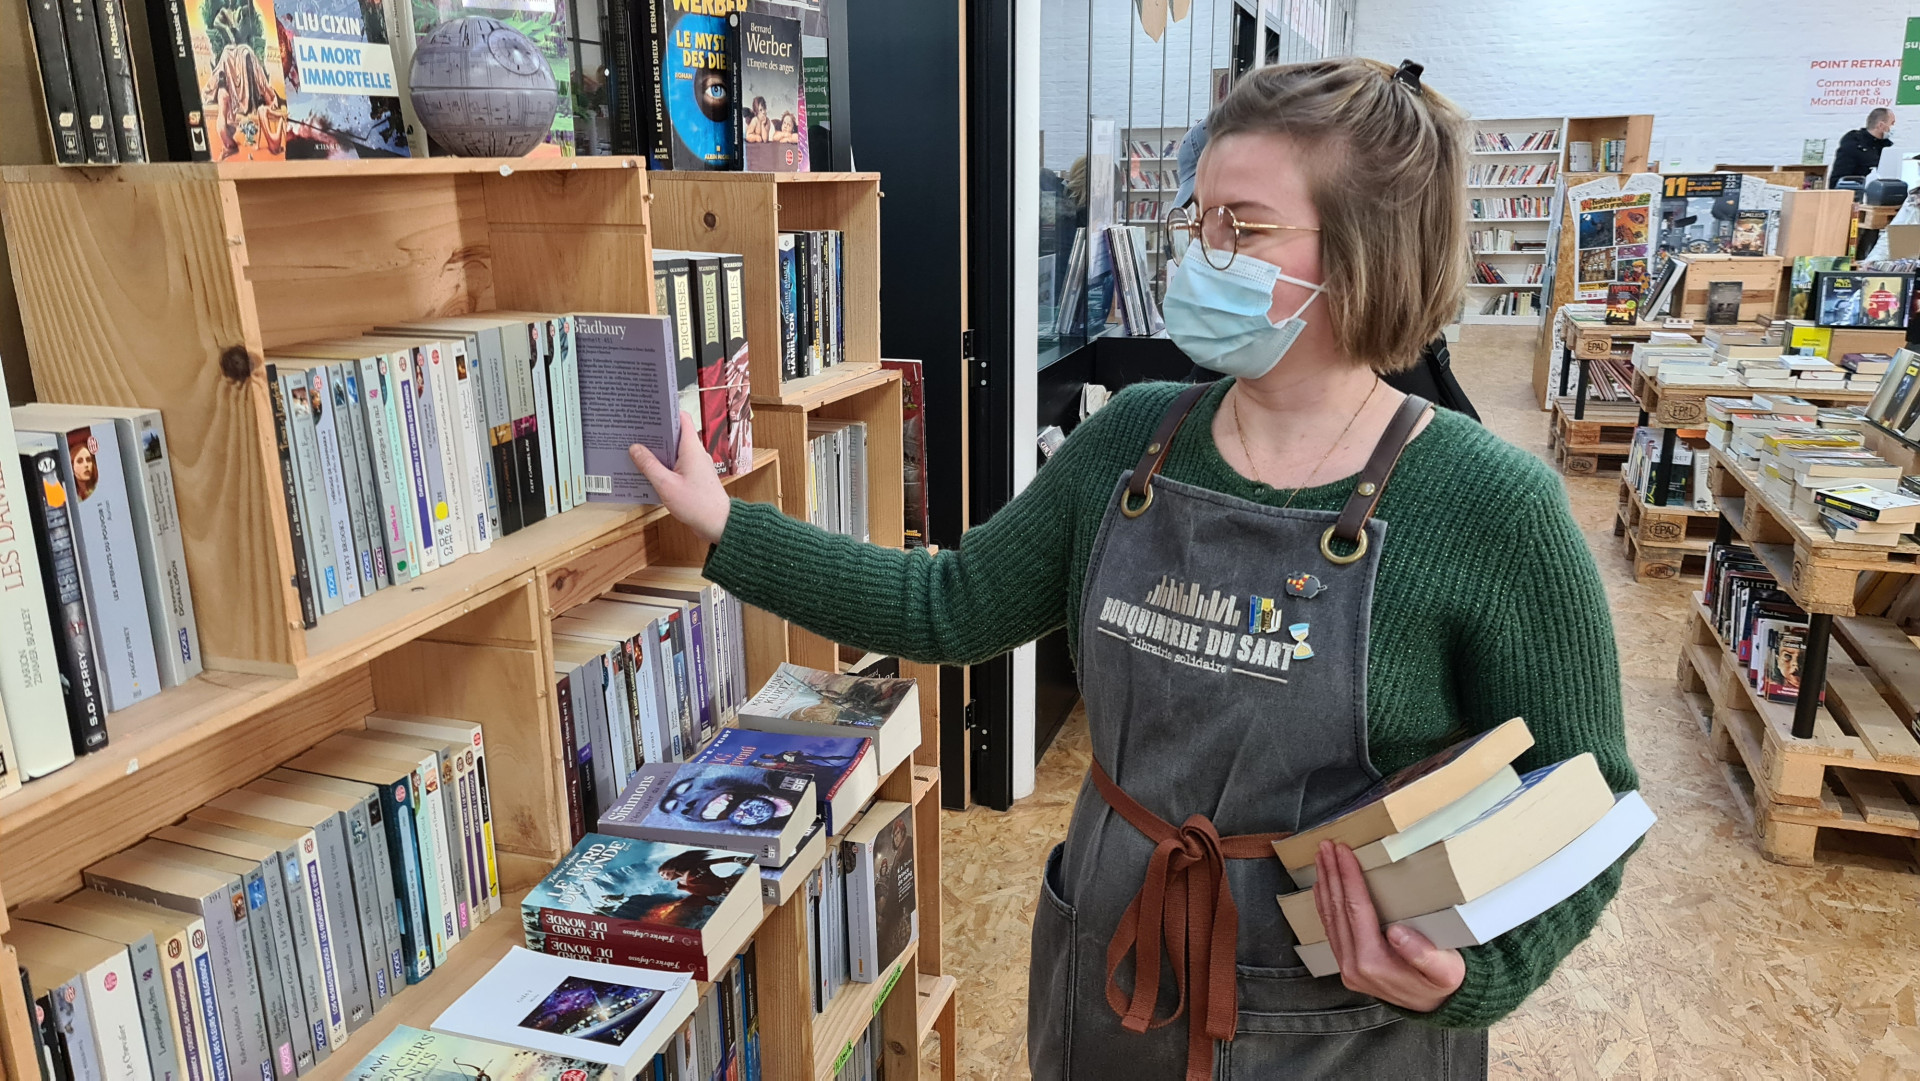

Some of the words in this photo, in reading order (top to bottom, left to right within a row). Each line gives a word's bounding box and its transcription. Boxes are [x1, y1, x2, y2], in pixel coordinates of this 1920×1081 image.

[106, 2, 114, 14] de
[170, 2, 178, 13] de
[108, 15, 120, 46] Messie
[172, 14, 184, 46] Messie
[294, 11, 318, 32] LIU
[320, 14, 360, 35] CIXIN
[750, 22, 772, 34] Bernard
[114, 47, 122, 59] Le
[179, 46, 186, 58] Le
[676, 30, 692, 48] LE
[695, 34, 726, 53] MYST
[746, 32, 792, 58] Werber
[299, 44, 318, 62] LA
[320, 46, 362, 66] MORT
[683, 52, 706, 68] DES
[710, 54, 728, 70] DIE
[747, 58, 768, 70] L'Empire
[770, 61, 778, 70] des
[779, 64, 794, 74] anges
[1810, 60, 1849, 70] POINT
[1851, 58, 1903, 69] RETRAIT
[302, 68, 392, 88] IMMORTELLE
[675, 72, 692, 80] ROMAN
[1816, 78, 1892, 88] Commandes
[654, 83, 662, 120] MYSTÈRE
[1810, 97, 1857, 106] Mondial
[1860, 97, 1893, 108] Relay
[1824, 88, 1870, 97] internet
[1874, 88, 1880, 96] &
[656, 123, 663, 132] LE
[1664, 177, 1688, 197] 11
[706, 280, 716, 338] RUMEURS
[730, 275, 740, 332] REBELLES
[678, 281, 689, 352] TRICHEUSES
[574, 320, 626, 340] Bradbury
[1588, 342, 1606, 350] EPAL
[404, 384, 412, 408] BANNIS
[479, 414, 485, 422] La
[1673, 406, 1695, 417] EPAL
[376, 428, 384, 436] de
[409, 424, 417, 448] CHEMIN
[377, 438, 389, 471] sortilèges
[382, 472, 391, 484] Les
[389, 505, 397, 518] Lee
[98, 509, 109, 540] POUVOIR
[339, 520, 349, 552] BROOKS
[391, 521, 400, 541] Tanith
[477, 513, 486, 540] POCKET
[1654, 524, 1676, 535] EPAL
[104, 542, 111, 552] DU
[2, 550, 25, 592] LES
[106, 553, 117, 588] ARTEFACTS
[343, 554, 353, 580] TERRY
[361, 550, 372, 581] POCKET
[374, 547, 384, 576] POCKET
[171, 560, 184, 616] DONALDSON
[325, 565, 337, 598] POCKET
[112, 590, 120, 600] LES
[21, 608, 35, 646] BRADLEY
[1100, 597, 1202, 652] BOUQUINERIE
[1205, 628, 1236, 658] DU
[1236, 634, 1295, 670] SART
[179, 628, 190, 664] POCKET
[1131, 637, 1172, 660] librairie
[1174, 654, 1226, 673] solidaire
[18, 650, 34, 688] MARION
[78, 650, 95, 697] PERRY
[752, 674, 784, 707] KATHERINE
[764, 680, 792, 705] KURTZ
[793, 779, 808, 792] SF
[608, 775, 656, 822] Simmons
[548, 880, 568, 898] LE
[566, 844, 606, 877] BORD
[580, 841, 626, 882] MONDE
[314, 889, 321, 898] DE
[444, 912, 453, 938] POCKET
[459, 902, 468, 928] POCKET
[546, 914, 586, 928] MONDE
[592, 921, 607, 932] DU
[552, 925, 585, 938] BORD
[589, 932, 604, 940] LE
[622, 929, 648, 938] Anfosso
[650, 932, 674, 944] Fabrice
[323, 947, 331, 969] BUJOLD
[551, 940, 592, 954] MONDE
[597, 948, 613, 958] DU
[392, 949, 402, 978] POCKET
[199, 959, 211, 995] ALGERNON
[327, 970, 336, 1000] McMASTER
[377, 969, 385, 998] POCKET
[205, 997, 214, 1015] POUR
[184, 1024, 194, 1051] STATIONS
[209, 1016, 218, 1040] FLEURS
[313, 1020, 325, 1050] POCKET
[213, 1042, 221, 1055] DES
[280, 1043, 291, 1075] POCKET
[381, 1034, 436, 1081] SAGERS
[125, 1064, 133, 1075] Le
[216, 1059, 225, 1079] KEYES
[370, 1054, 390, 1072] AVIT
[404, 1052, 438, 1080] NTS
